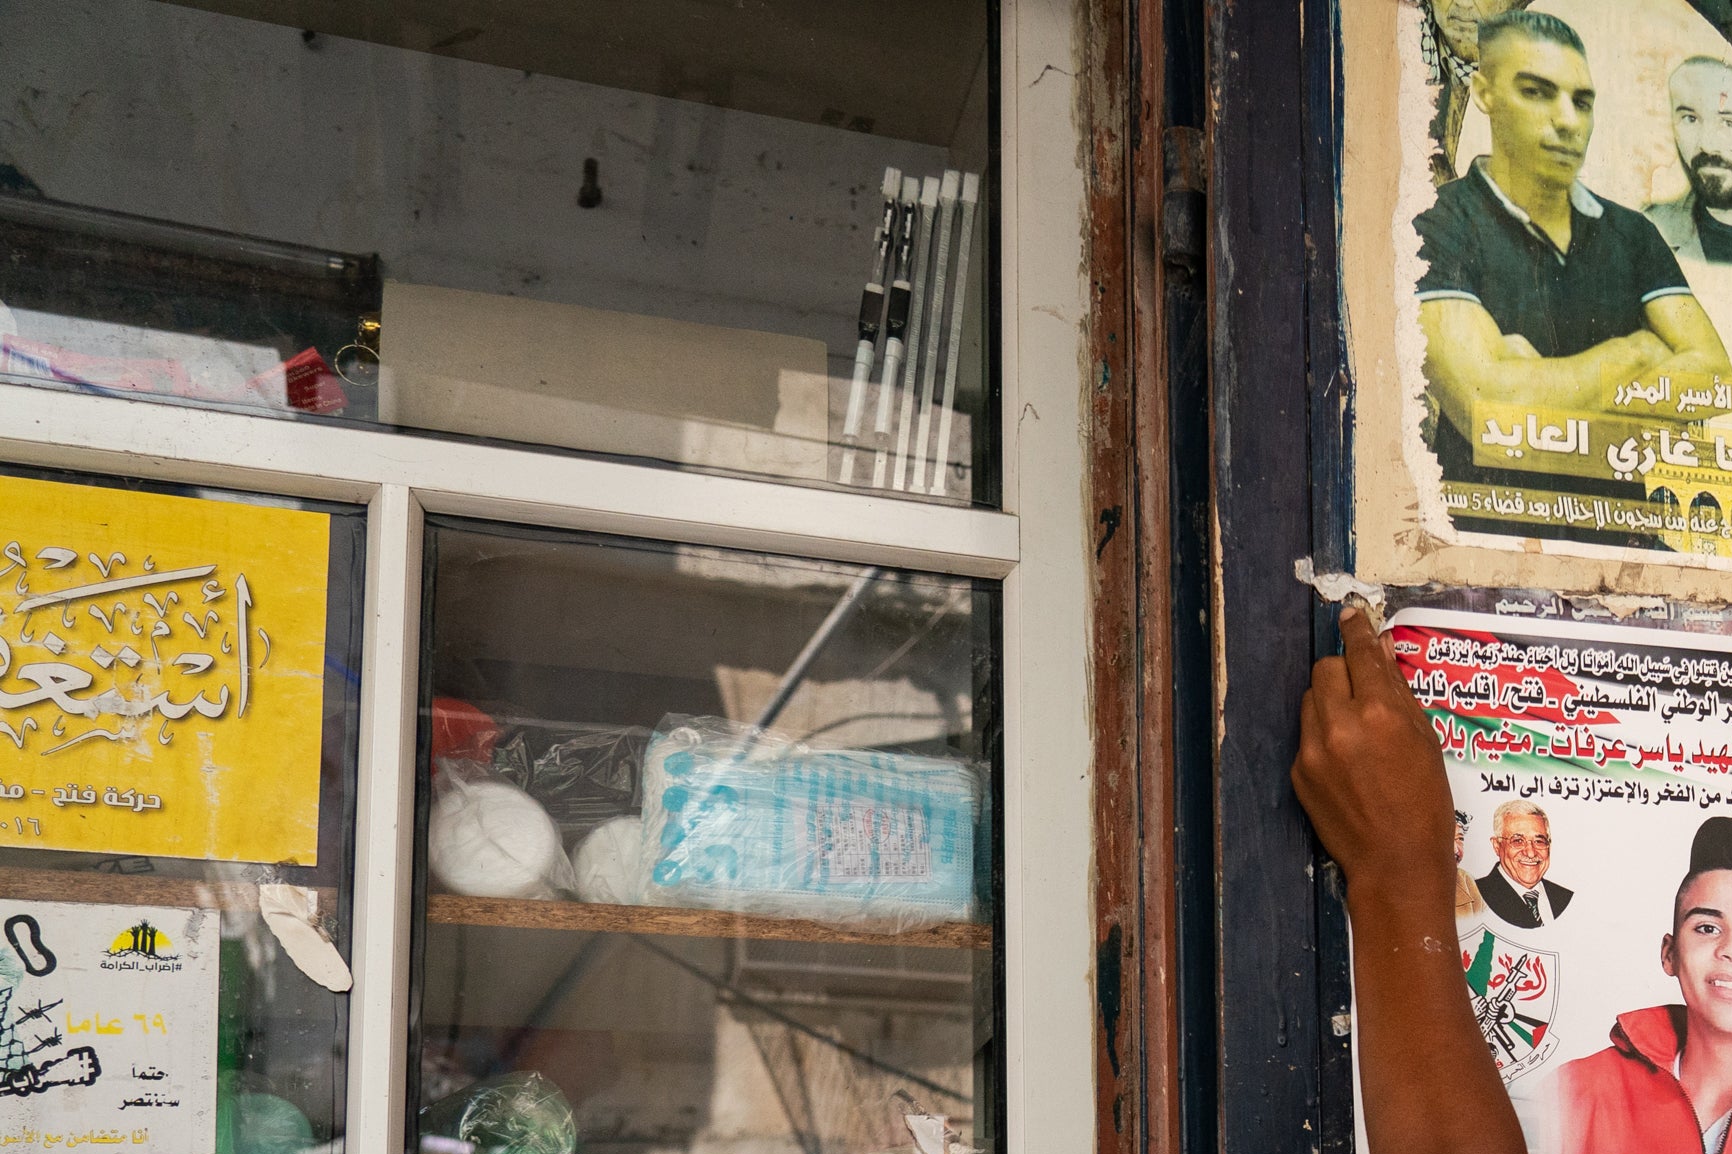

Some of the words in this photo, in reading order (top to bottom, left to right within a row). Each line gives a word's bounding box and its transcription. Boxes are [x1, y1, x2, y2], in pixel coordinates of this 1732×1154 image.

[1614, 376, 1670, 406] المحرر
[1676, 375, 1731, 413] الأسير
[1482, 413, 1589, 459] العايد
[1607, 430, 1699, 482] غازي
[1472, 493, 1482, 509] 5
[1484, 489, 1524, 515] قضاء
[1528, 500, 1551, 523] بعد
[1451, 673, 1498, 708] إقليم
[1563, 684, 1657, 718] الفلسطيني
[1662, 689, 1717, 723] الوطني
[1471, 720, 1532, 760] مخيم
[1551, 723, 1627, 766] عرفات
[1634, 734, 1684, 772] ياسر
[52, 783, 97, 807] فتح
[1480, 772, 1516, 793] العلا
[1520, 774, 1544, 798] إلى
[1656, 782, 1695, 806] الفخر
[103, 787, 162, 812] حركة
[1700, 786, 1723, 808] من
[43, 1133, 63, 1149] مع
[66, 1129, 127, 1149] متضامن
[131, 1127, 150, 1144] أنا
